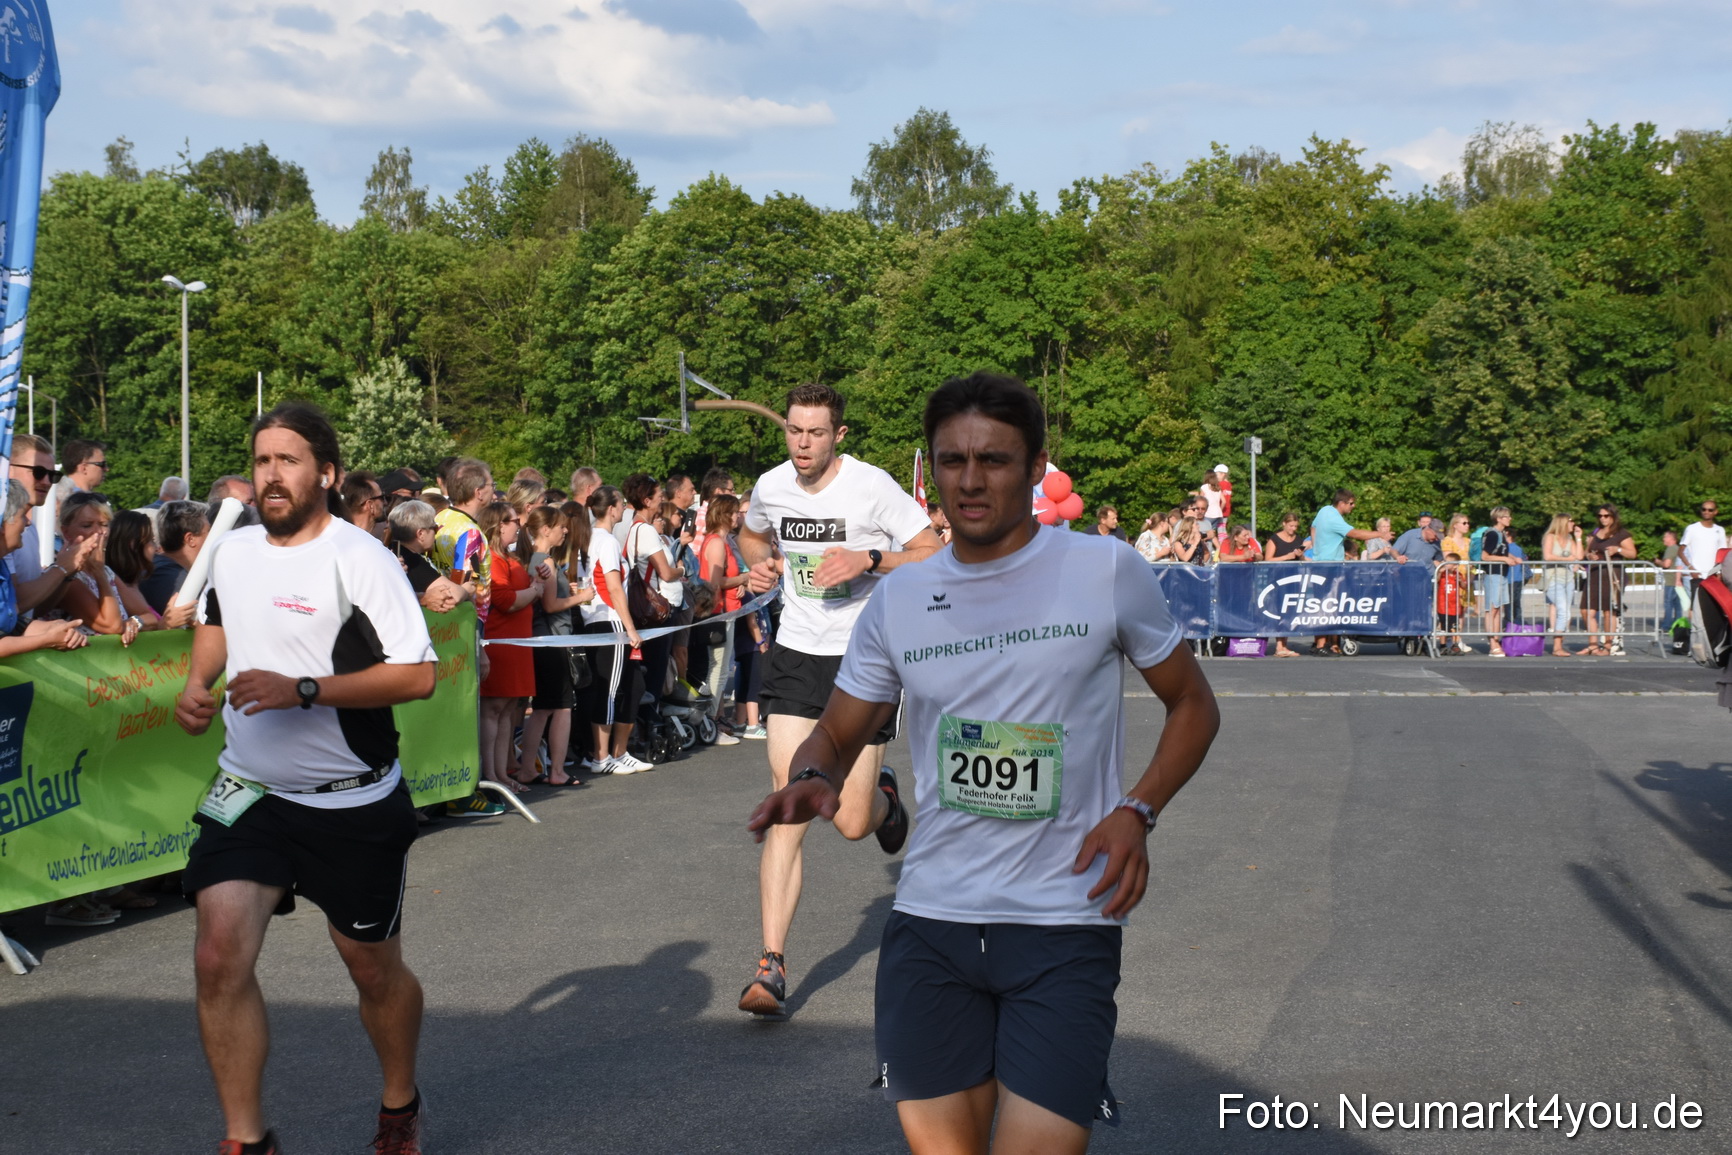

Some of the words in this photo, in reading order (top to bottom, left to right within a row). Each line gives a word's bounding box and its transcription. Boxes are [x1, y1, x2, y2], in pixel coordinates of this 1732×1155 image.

[785, 522, 826, 539] KOPP
[828, 523, 837, 539] ?
[797, 569, 815, 586] 15
[927, 602, 951, 612] erima
[1281, 592, 1388, 614] Fischer
[1290, 615, 1378, 625] AUTOMOBILE
[904, 635, 996, 665] RUPPRECHT
[1005, 623, 1089, 646] HOLZBAU
[148, 652, 192, 685] Firme
[436, 642, 471, 686] änger!
[1030, 749, 1054, 757] 2019
[950, 751, 1039, 792] 2091
[959, 787, 1009, 802] Federhofer
[1010, 792, 1035, 803] Felix
[987, 800, 1014, 810] Holzbau
[1015, 802, 1037, 811] GmbH
